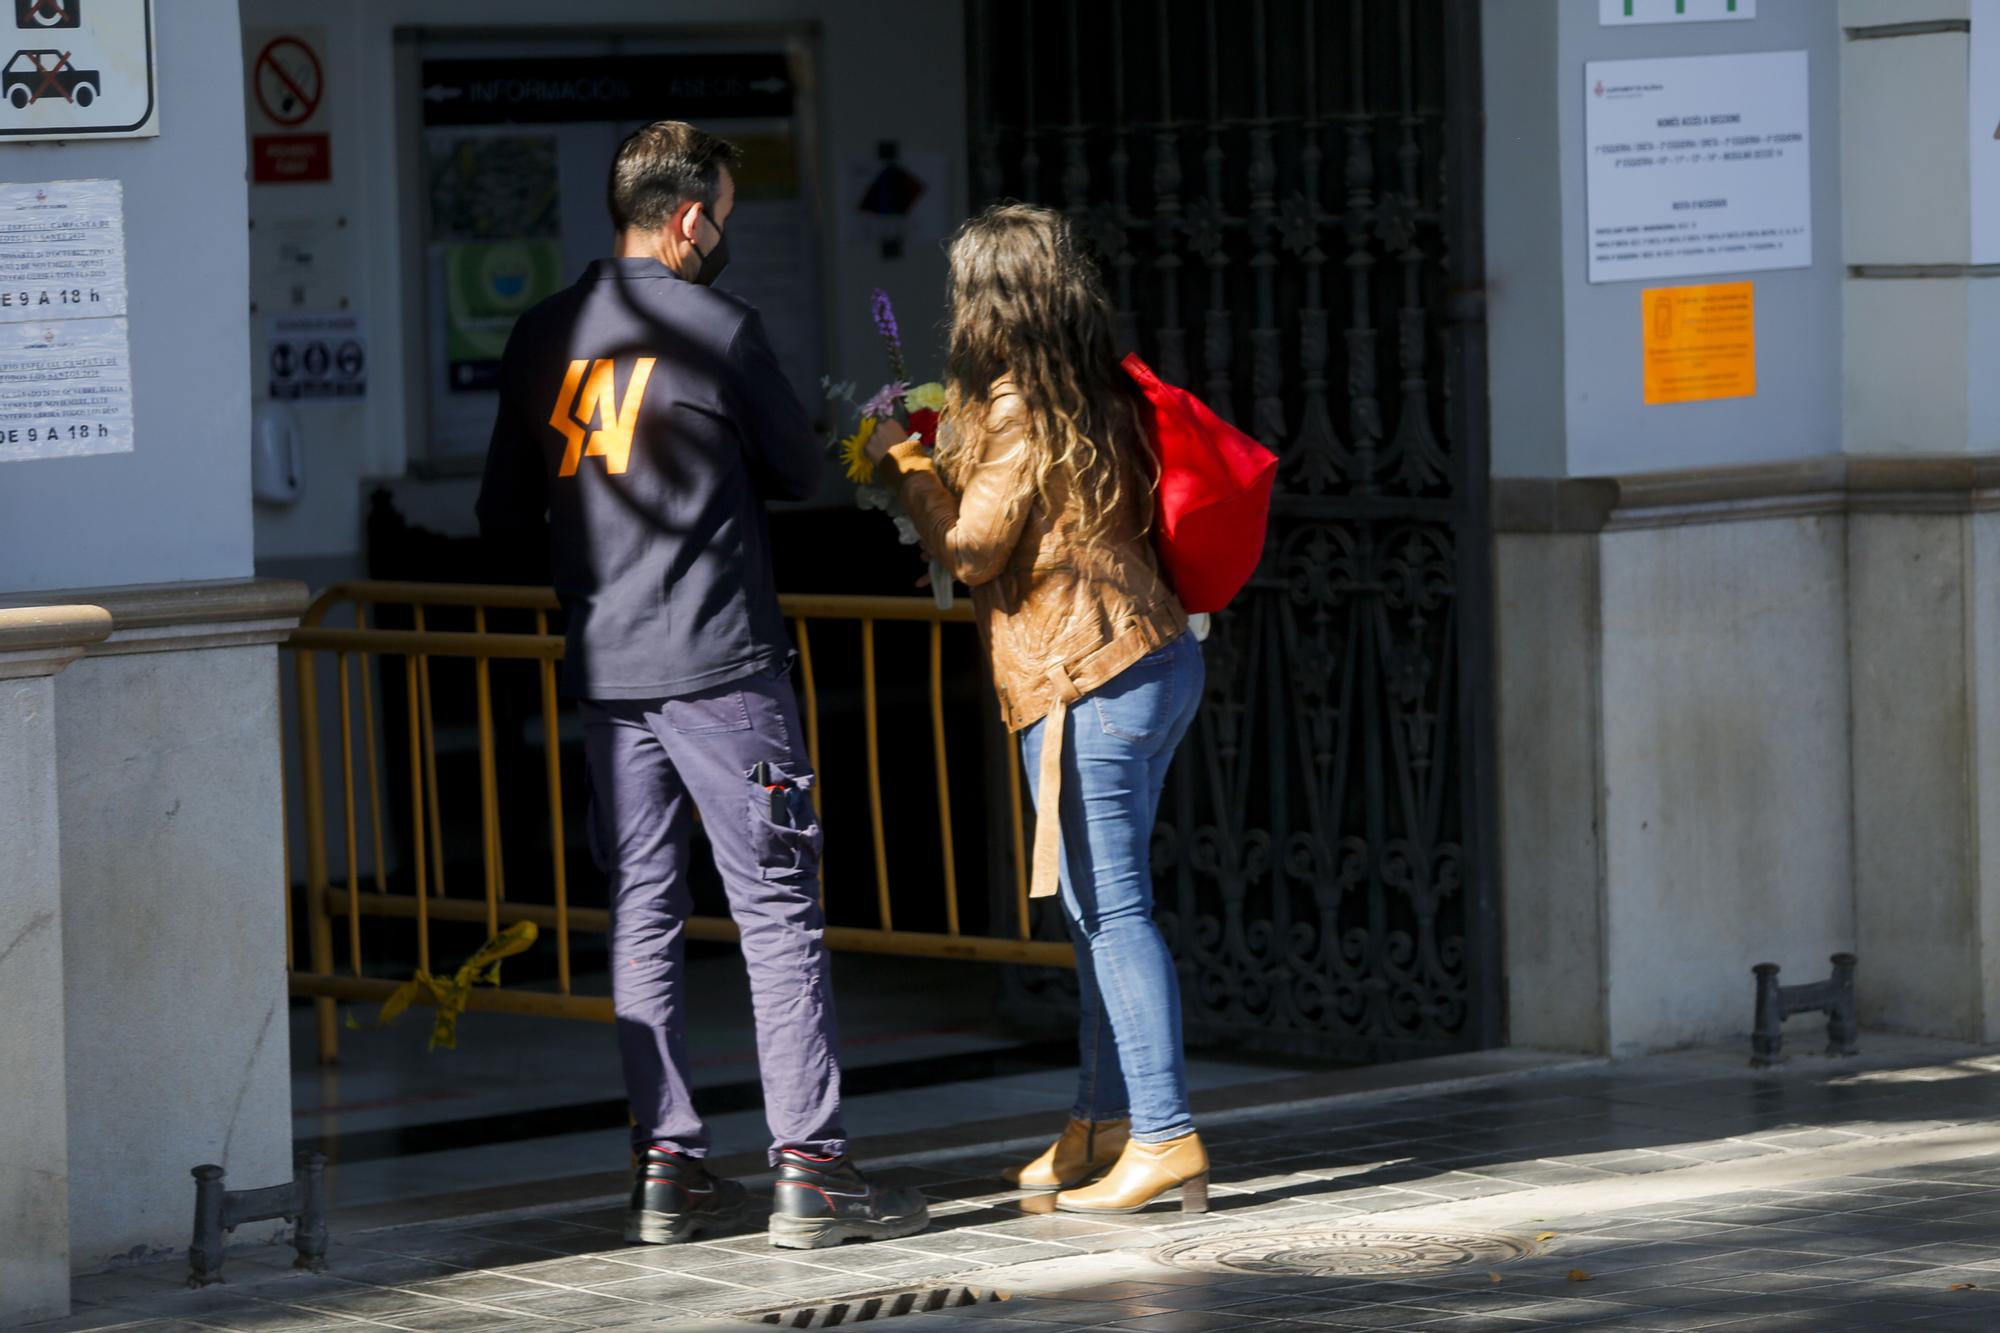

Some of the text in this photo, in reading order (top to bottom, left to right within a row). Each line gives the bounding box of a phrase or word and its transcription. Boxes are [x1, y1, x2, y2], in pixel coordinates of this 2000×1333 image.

[0, 288, 100, 307] E 9 A 18 h
[28, 428, 37, 442] 9
[47, 426, 59, 441] A
[68, 425, 89, 440] 18
[98, 423, 108, 438] h
